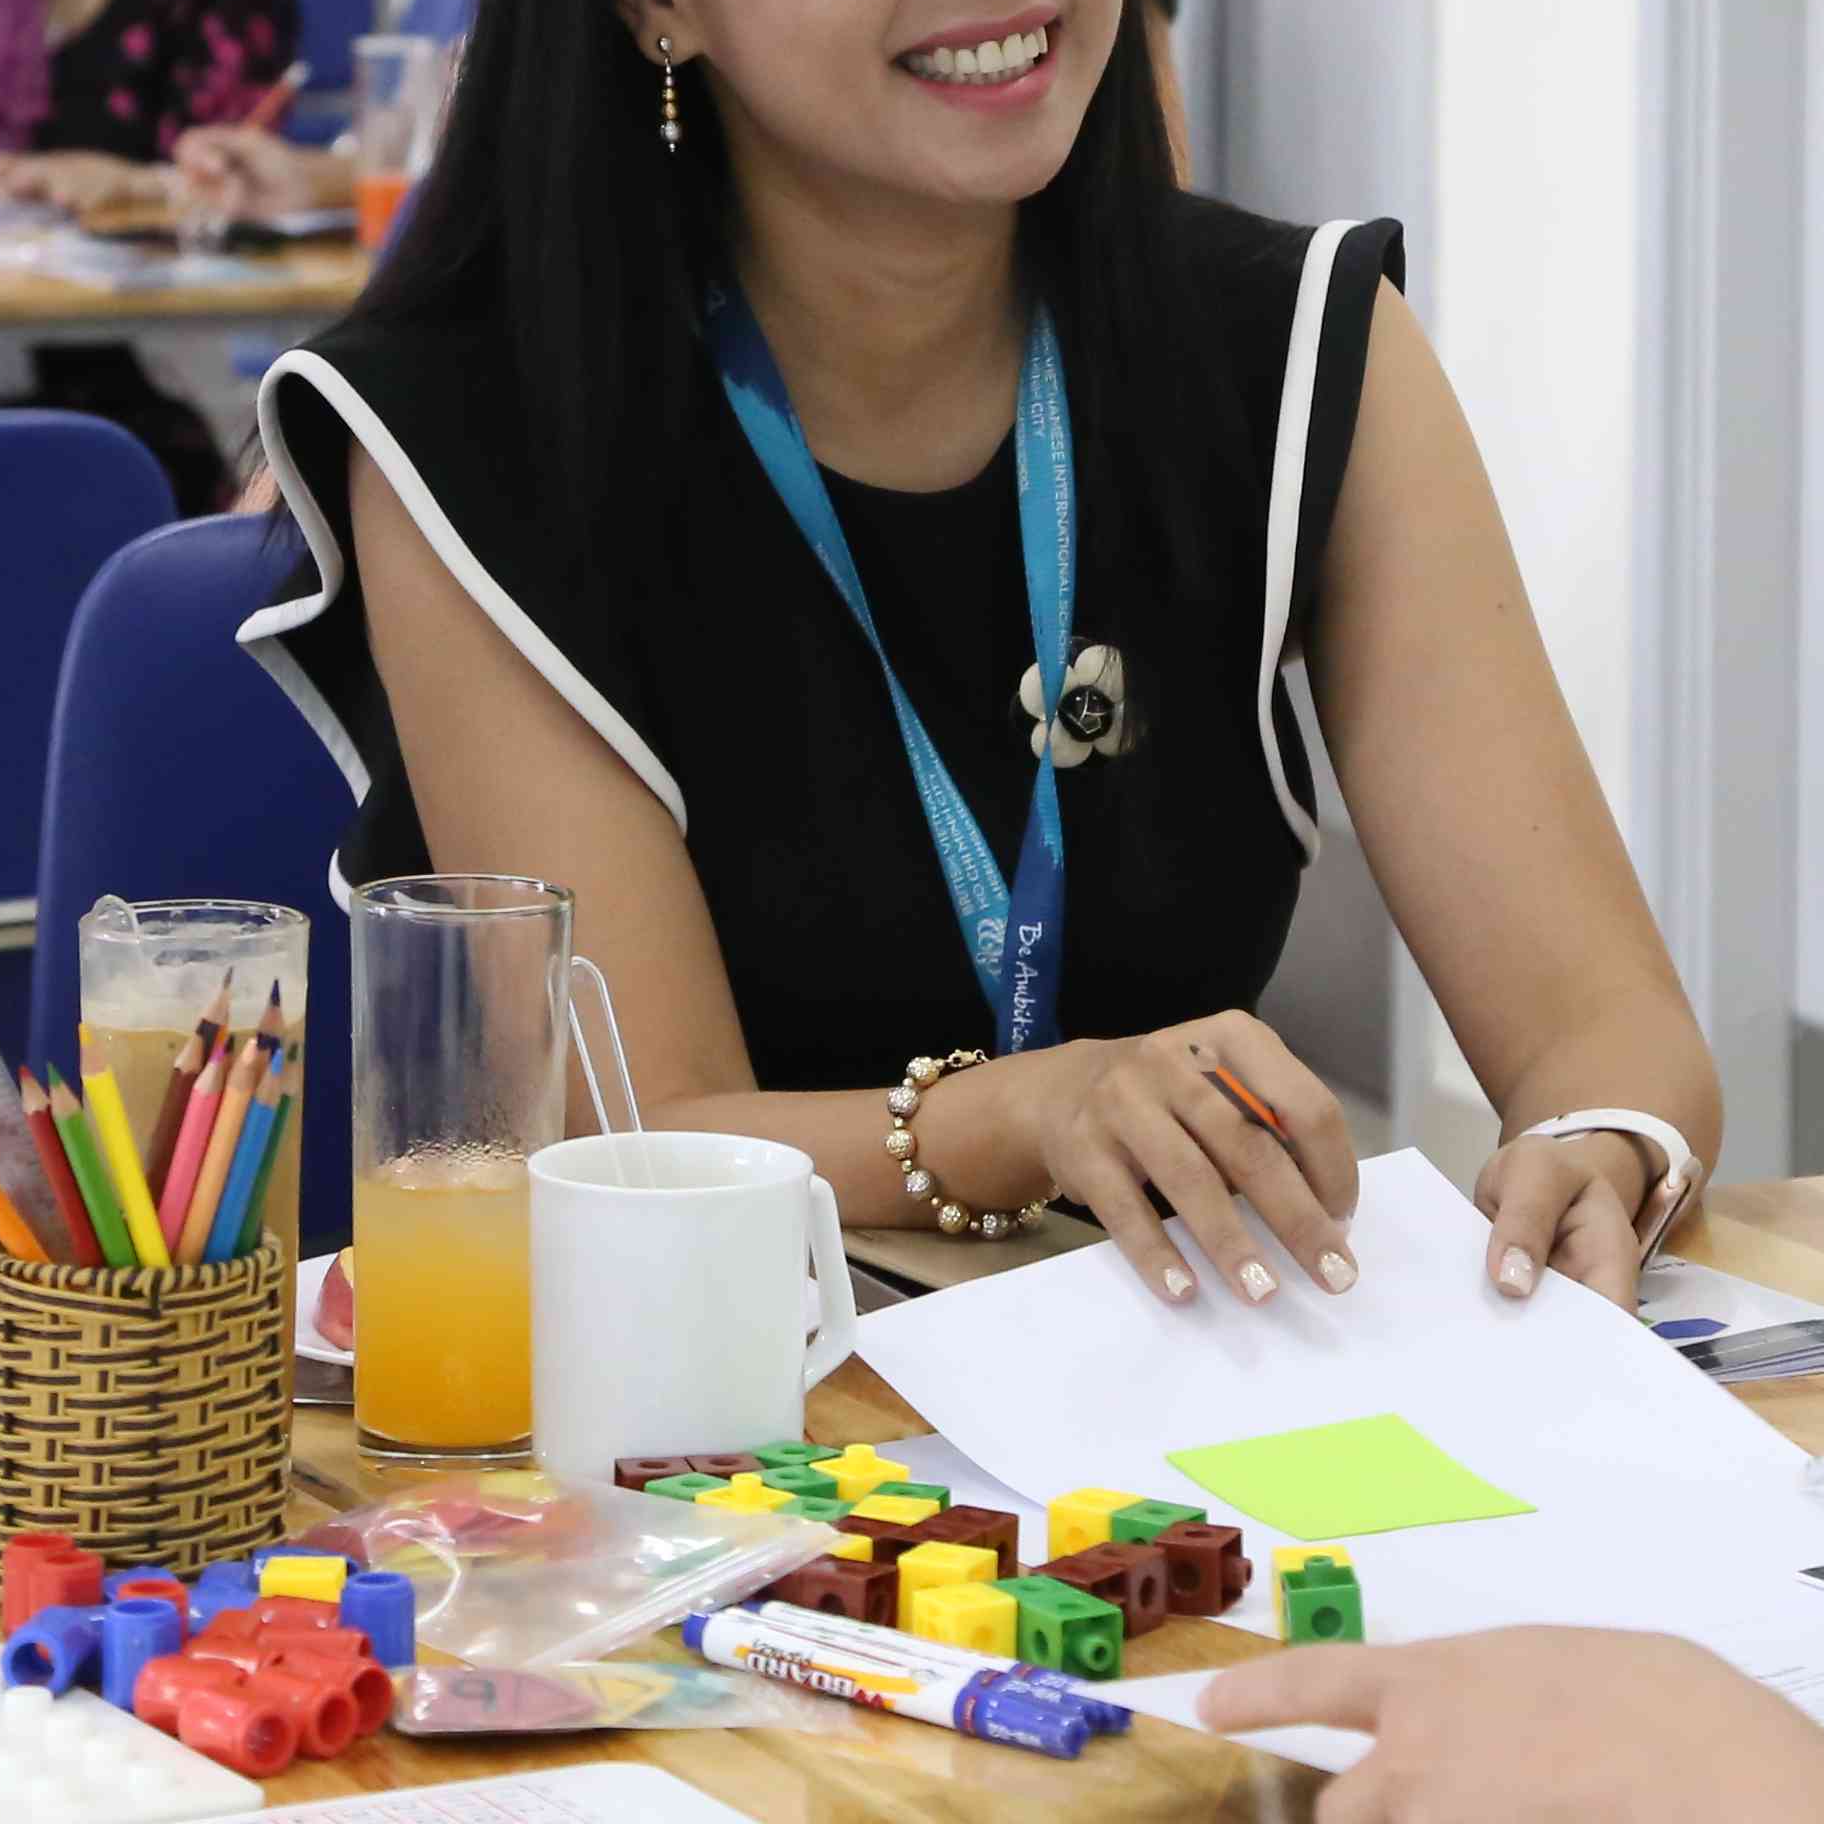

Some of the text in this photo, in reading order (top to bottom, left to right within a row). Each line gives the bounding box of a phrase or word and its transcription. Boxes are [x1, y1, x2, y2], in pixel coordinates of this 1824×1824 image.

[1031, 403, 1047, 439] CITY
[1044, 356, 1065, 461] VIETNAMESE
[1054, 463, 1071, 596] INTERNATIONAL
[1017, 921, 1043, 959] Be
